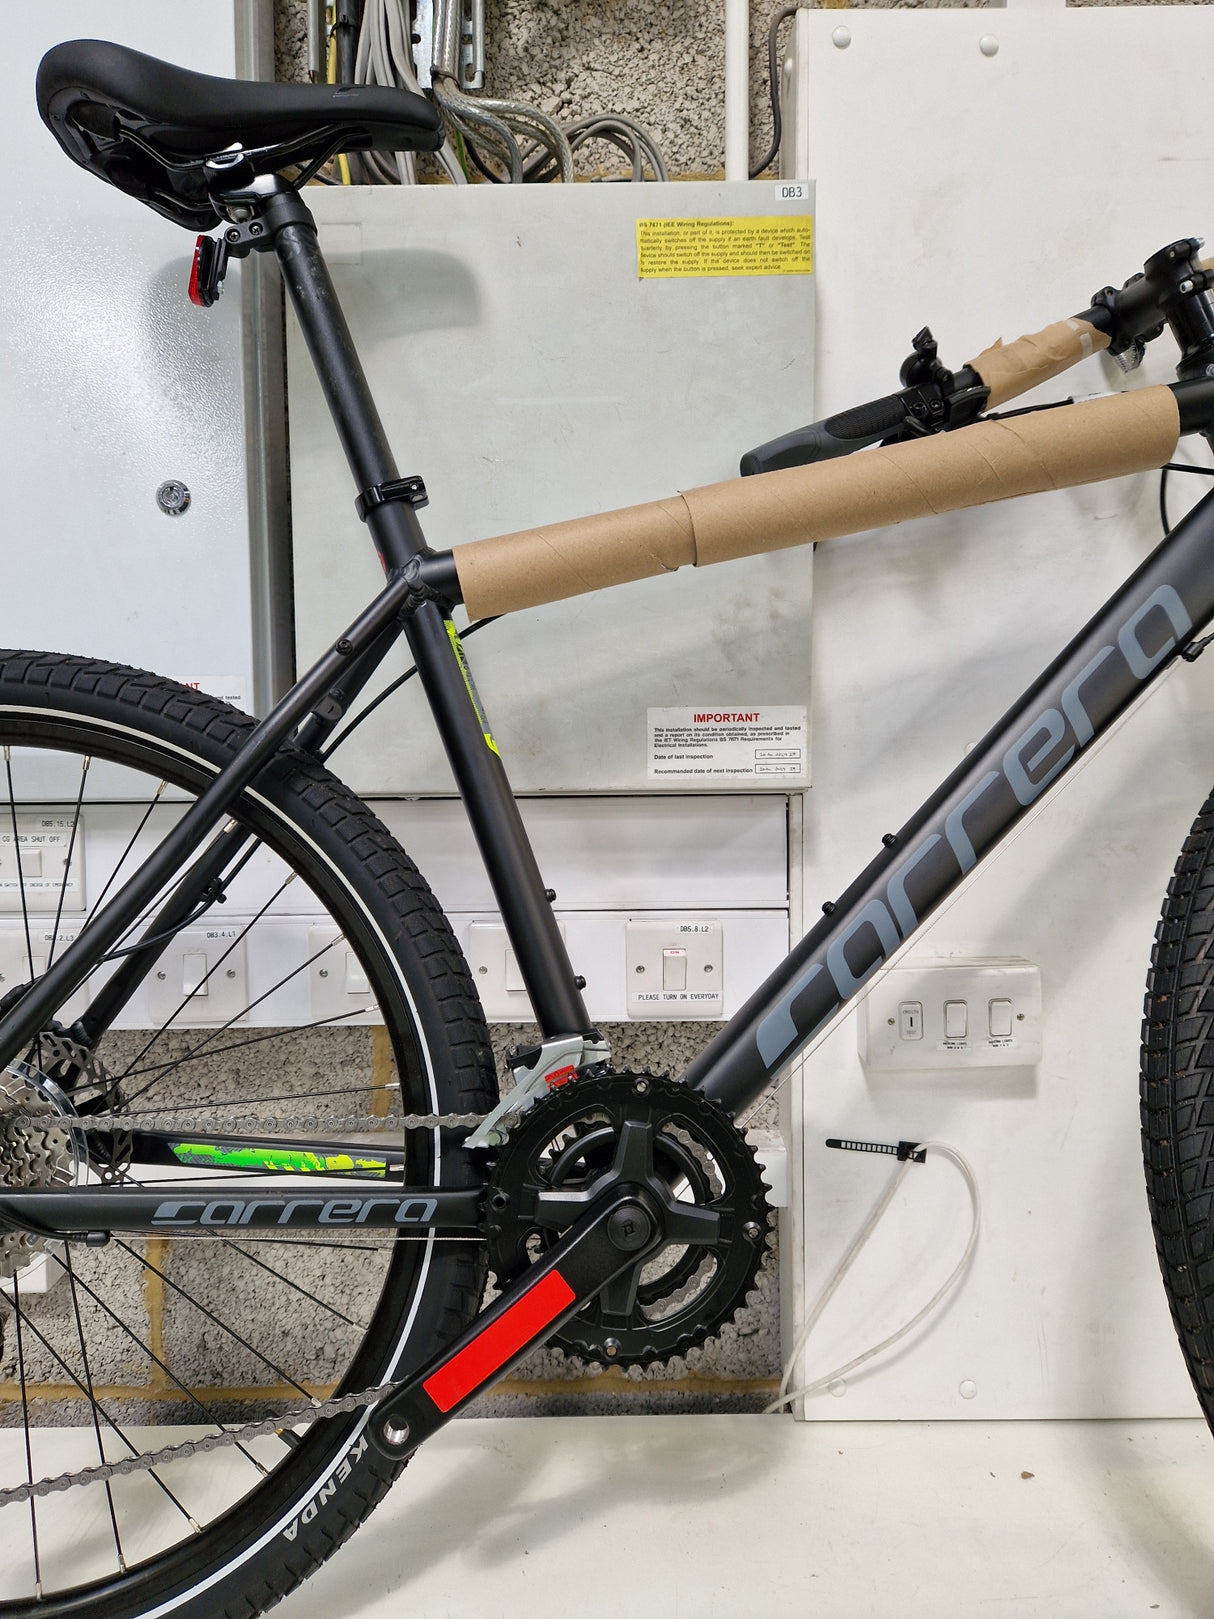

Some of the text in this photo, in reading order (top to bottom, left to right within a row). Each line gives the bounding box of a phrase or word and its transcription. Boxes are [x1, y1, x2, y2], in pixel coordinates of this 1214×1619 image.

[782, 186, 802, 198] DB3
[693, 713, 760, 723] IMPORTANT
[151, 1199, 438, 1225] carrera
[282, 1434, 369, 1542] KENDA
